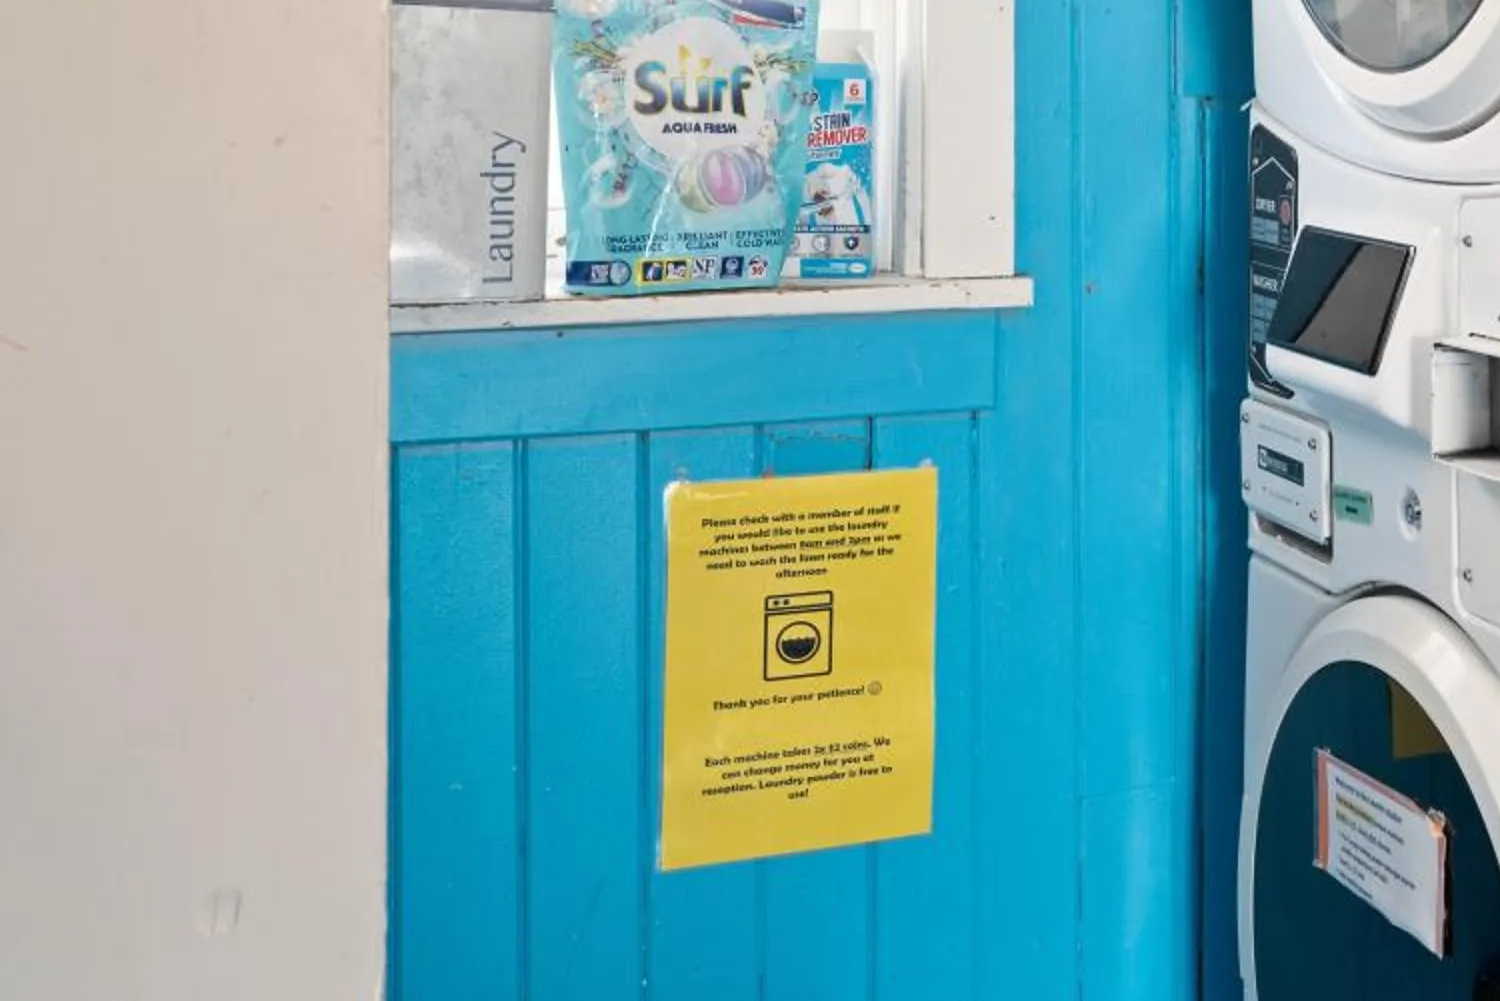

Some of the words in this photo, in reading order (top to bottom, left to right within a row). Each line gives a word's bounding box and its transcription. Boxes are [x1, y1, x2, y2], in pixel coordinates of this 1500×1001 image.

[634, 57, 754, 117] Surf
[850, 82, 859, 96] 6
[662, 122, 700, 134] AQUA
[703, 122, 737, 134] FRESH
[814, 113, 850, 131] STAIN
[808, 127, 866, 147] REMOVER
[480, 130, 527, 283] Laundry
[702, 518, 737, 528] Please
[739, 513, 769, 525] check
[772, 511, 795, 522] with
[798, 513, 805, 521] a
[807, 509, 851, 520] member
[854, 506, 864, 516] of
[714, 533, 735, 543] you
[737, 528, 770, 541] would
[773, 526, 792, 537] like
[795, 524, 806, 535] to
[808, 525, 825, 534] use
[828, 521, 844, 532] the
[847, 519, 889, 531] laundry
[699, 544, 749, 557] machines
[752, 540, 796, 552] between
[825, 535, 846, 547] and
[888, 533, 901, 542] we
[706, 558, 732, 570] need
[735, 557, 747, 568] to
[750, 554, 776, 567] wash
[779, 552, 796, 564] the
[827, 548, 857, 561] ready
[859, 546, 874, 557] for
[877, 545, 894, 556] the
[713, 699, 747, 711] Thank
[749, 698, 770, 709] you
[772, 694, 788, 705] for
[790, 693, 814, 704] your
[817, 685, 865, 700] patience!
[705, 756, 731, 768] Each
[734, 750, 780, 765] machine
[782, 747, 811, 759] takes
[874, 736, 891, 747] We
[722, 770, 741, 780] can
[744, 763, 783, 777] change
[785, 759, 820, 771] money
[823, 756, 838, 767] for
[841, 756, 860, 766] you
[862, 753, 874, 762] at
[702, 783, 756, 797] reception.
[759, 775, 804, 790] Laundry
[807, 770, 846, 784] powder
[859, 765, 879, 776] free
[881, 763, 893, 774] to
[787, 788, 809, 800] use!
